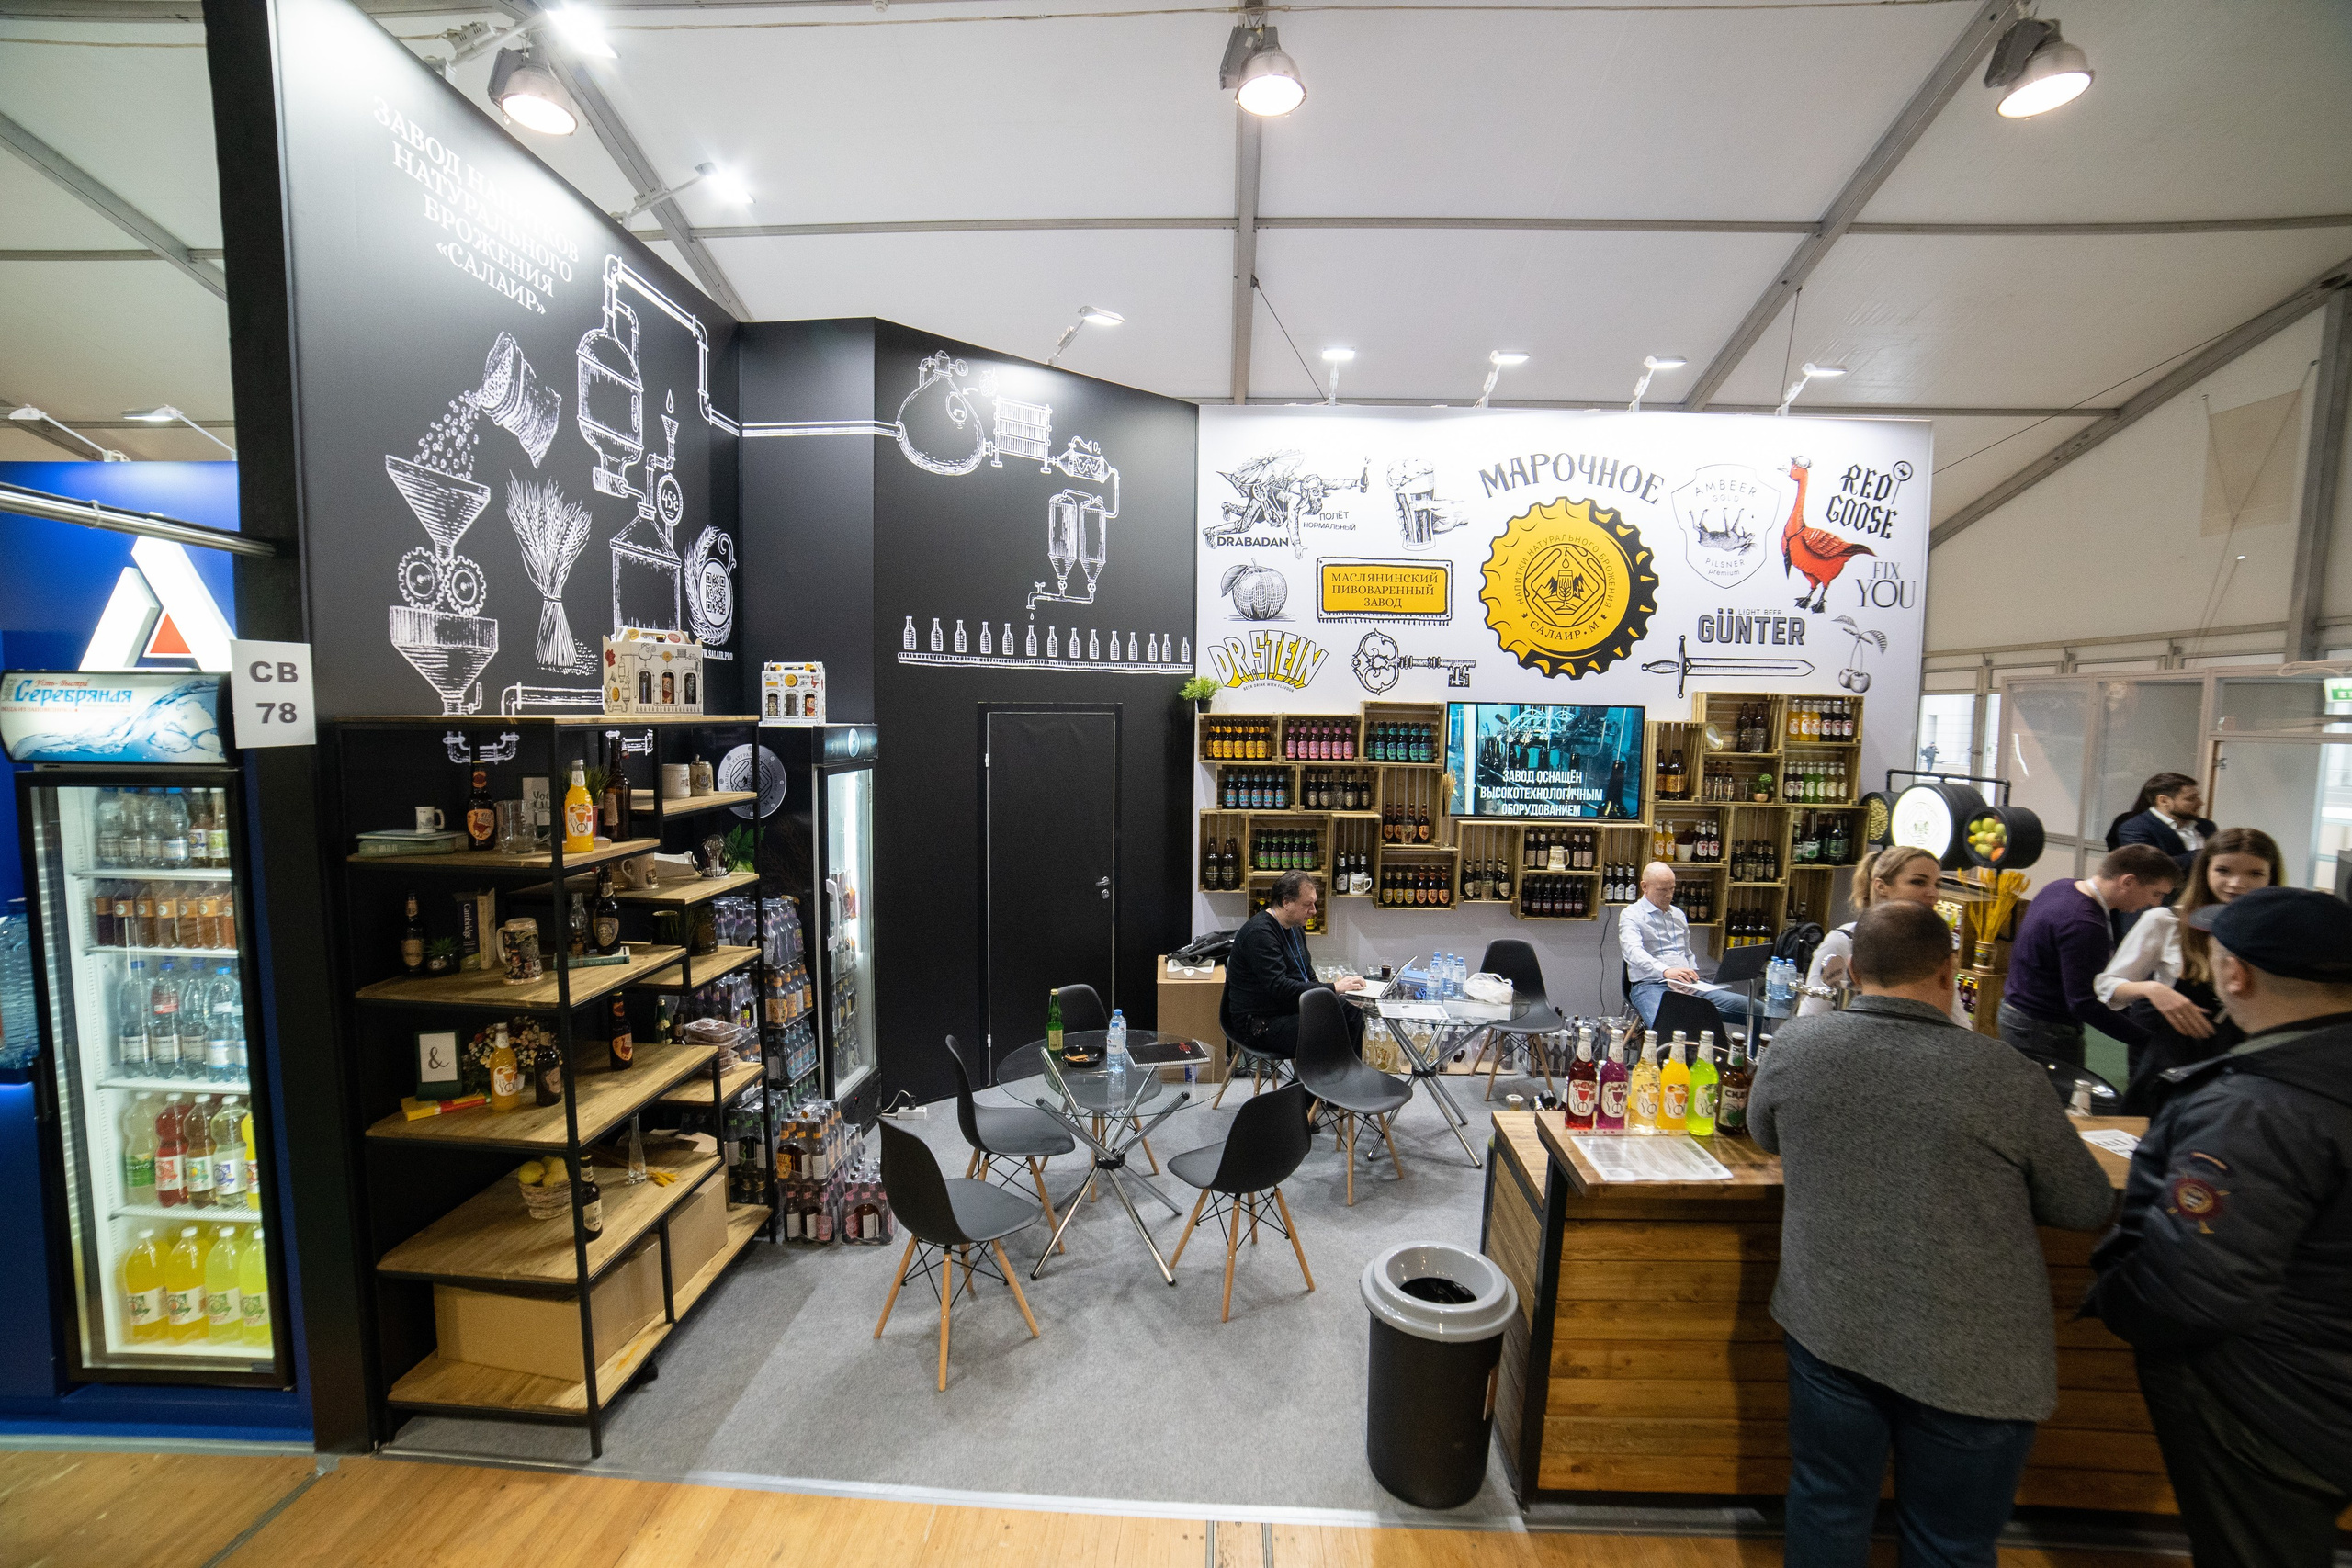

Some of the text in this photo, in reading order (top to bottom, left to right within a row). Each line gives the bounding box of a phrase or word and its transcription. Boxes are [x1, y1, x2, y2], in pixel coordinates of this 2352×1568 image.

[373, 95, 462, 186] ЗАВОД
[391, 140, 573, 283] НАТУРАЛЬНОГО
[423, 193, 554, 298] БРОЖЕНИЯ
[435, 242, 548, 316] «САЛАИР»
[1478, 452, 1665, 505] МАРОЧНОЕ
[1839, 464, 1893, 502] RED
[1695, 479, 1758, 498] AMBEER
[1712, 493, 1740, 503] GOLD
[1318, 511, 1350, 521] ПОЛЁТ
[1826, 495, 1898, 540] GOOSE
[1303, 521, 1356, 532] НОРМАЛЬНЫЙ
[1216, 536, 1289, 547] DRABADAN
[1514, 534, 1616, 608] НАПИТКИ НАТУРАЛЬНОГО БРОЖЕНИЯ
[1705, 558, 1746, 569] PILSNER
[1708, 569, 1740, 577] premium
[1873, 561, 1901, 580] FIX
[1331, 571, 1439, 584] МАСЛЯНИНСКИЙ
[1331, 583, 1435, 596] ПИВОВАРЕННЫЙ
[1855, 579, 1917, 609] YOU
[1363, 597, 1403, 609] ЗАВОД
[1698, 608, 1805, 645] GÜNTER
[15, 679, 132, 706] Серебряная
[1277, 683, 1295, 693] FLAVOUR
[255, 701, 299, 725] 78
[1502, 768, 1583, 785] ЗАВОД ОСНАЩЁН
[1480, 786, 1603, 801] ВЫСОКОТЕХНОЛОГИЧНЫМ
[1501, 803, 1581, 817] ОБОРУДОВАНИЕМ
[463, 903, 472, 940] Cambridge
